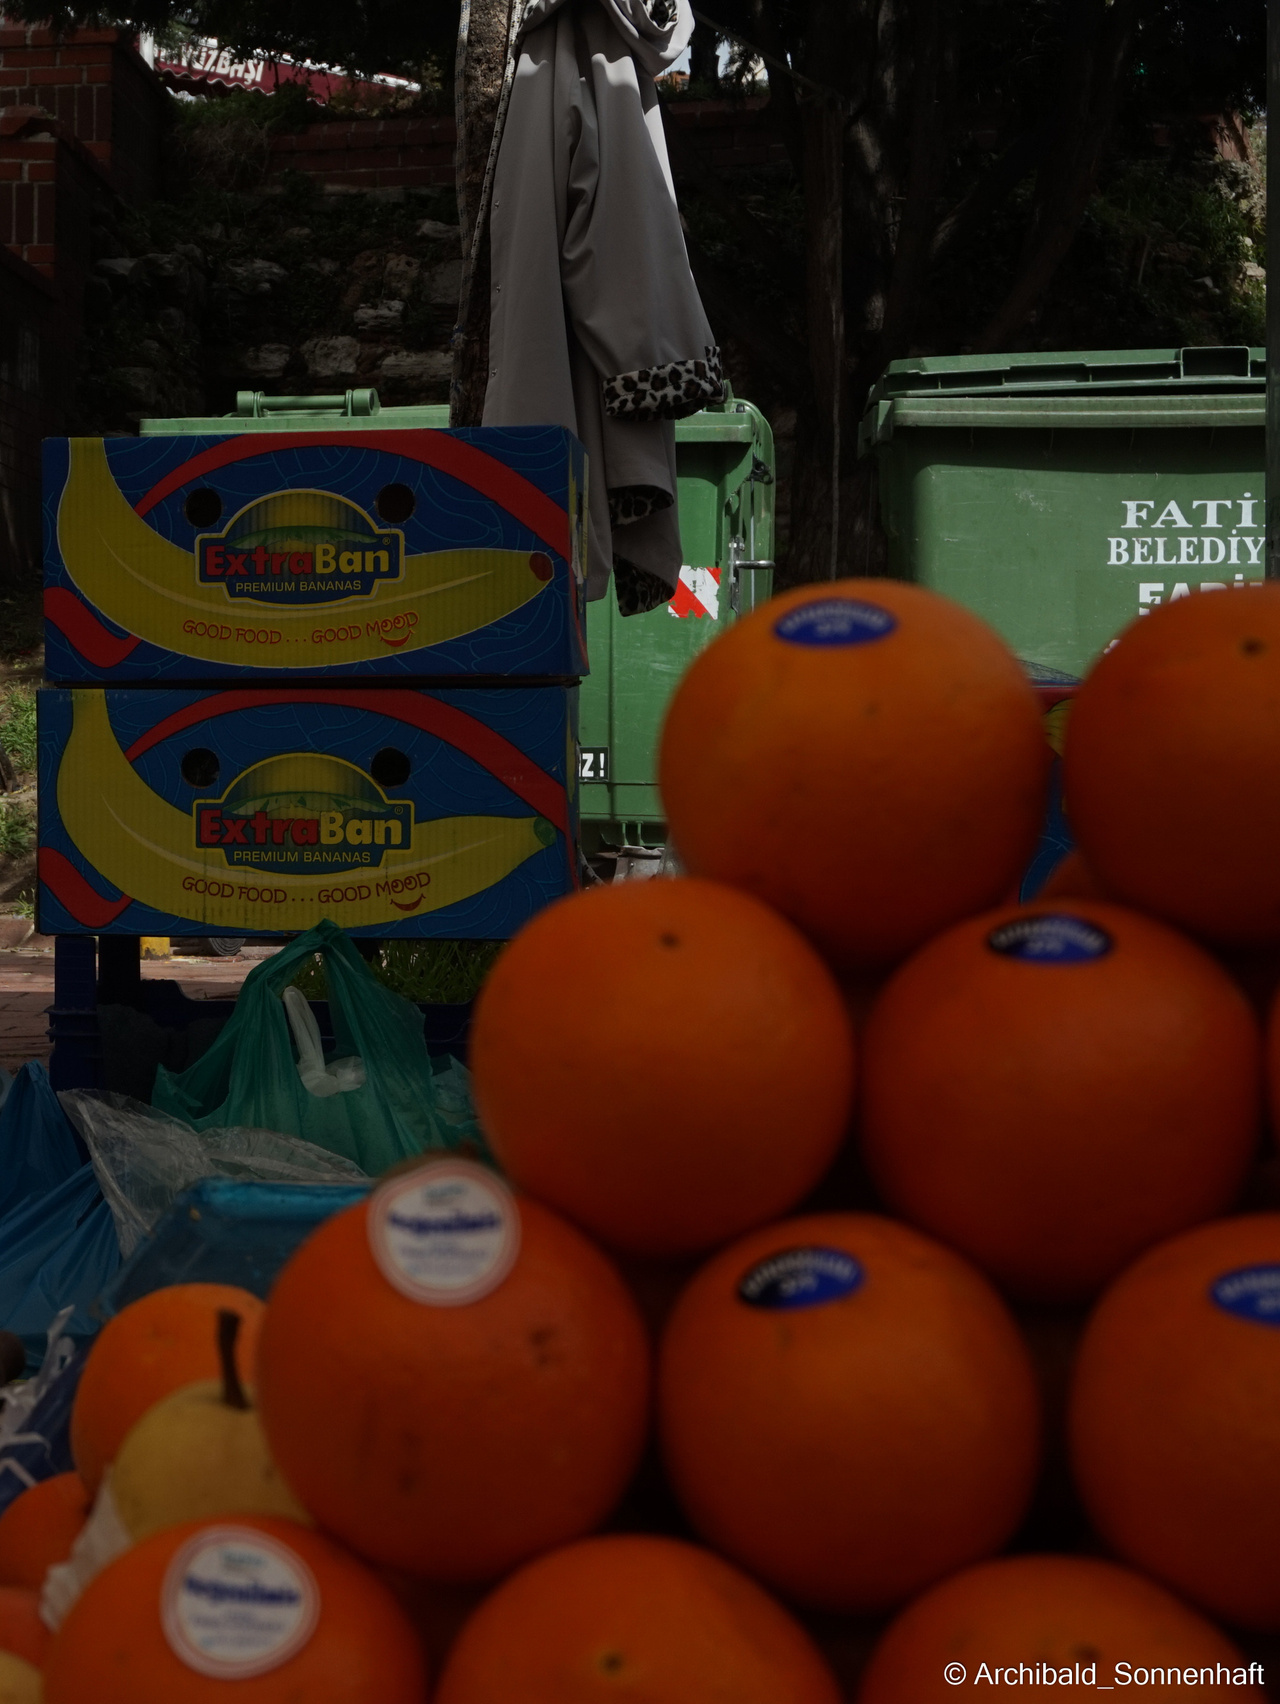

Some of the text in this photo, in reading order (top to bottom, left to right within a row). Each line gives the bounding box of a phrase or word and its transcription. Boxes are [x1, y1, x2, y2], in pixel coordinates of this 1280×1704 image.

[1121, 492, 1266, 528] FATİ
[205, 543, 390, 577] ExtraBan
[1107, 529, 1266, 565] BELEDİY
[235, 580, 362, 593] PREMIUM BANANAS
[182, 619, 232, 640] GOOD
[236, 628, 282, 644] FOOD
[311, 625, 362, 644] GOOD
[366, 611, 419, 636] MOOD
[199, 809, 403, 846] ExtraBan
[233, 850, 371, 863] PREMIUM BANANAS
[182, 876, 234, 898] GOOD
[238, 886, 287, 904] FOOD
[318, 885, 371, 904] GOOD
[376, 872, 431, 897] MOOD
